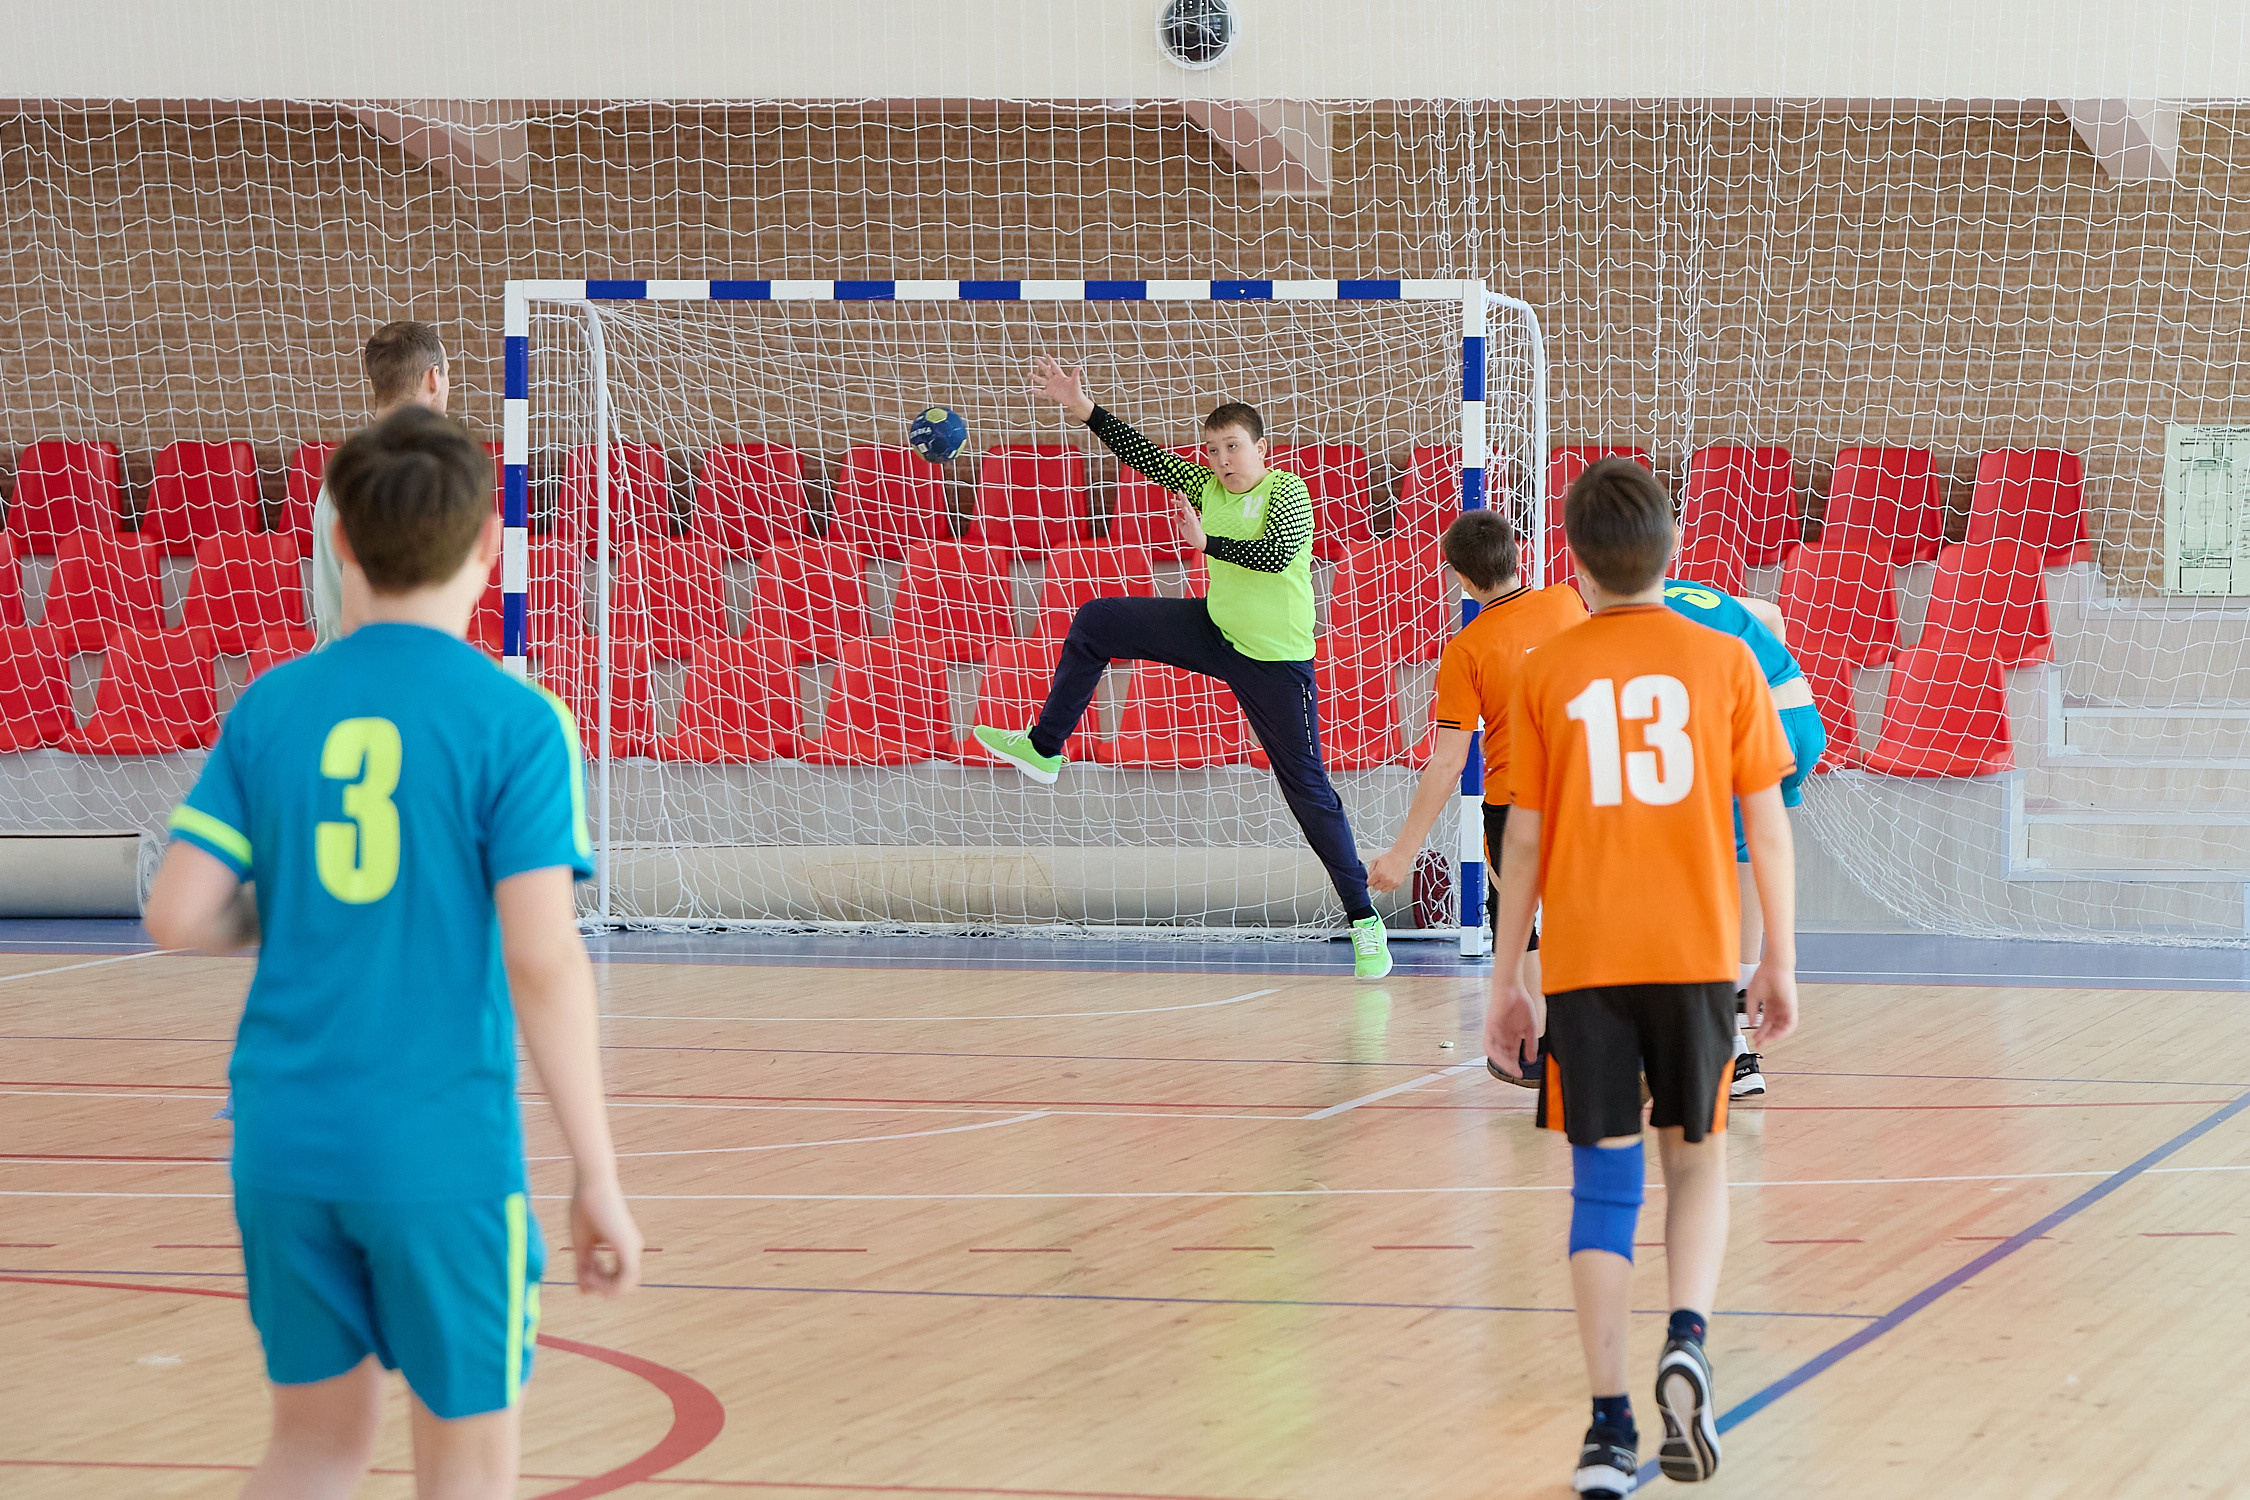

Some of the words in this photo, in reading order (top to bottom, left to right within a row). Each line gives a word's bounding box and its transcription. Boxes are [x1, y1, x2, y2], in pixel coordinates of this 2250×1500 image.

[1242, 495, 1263, 518] 12
[1566, 674, 1695, 807] 13
[316, 717, 402, 904] 3
[1736, 1067, 1751, 1076] FILA
